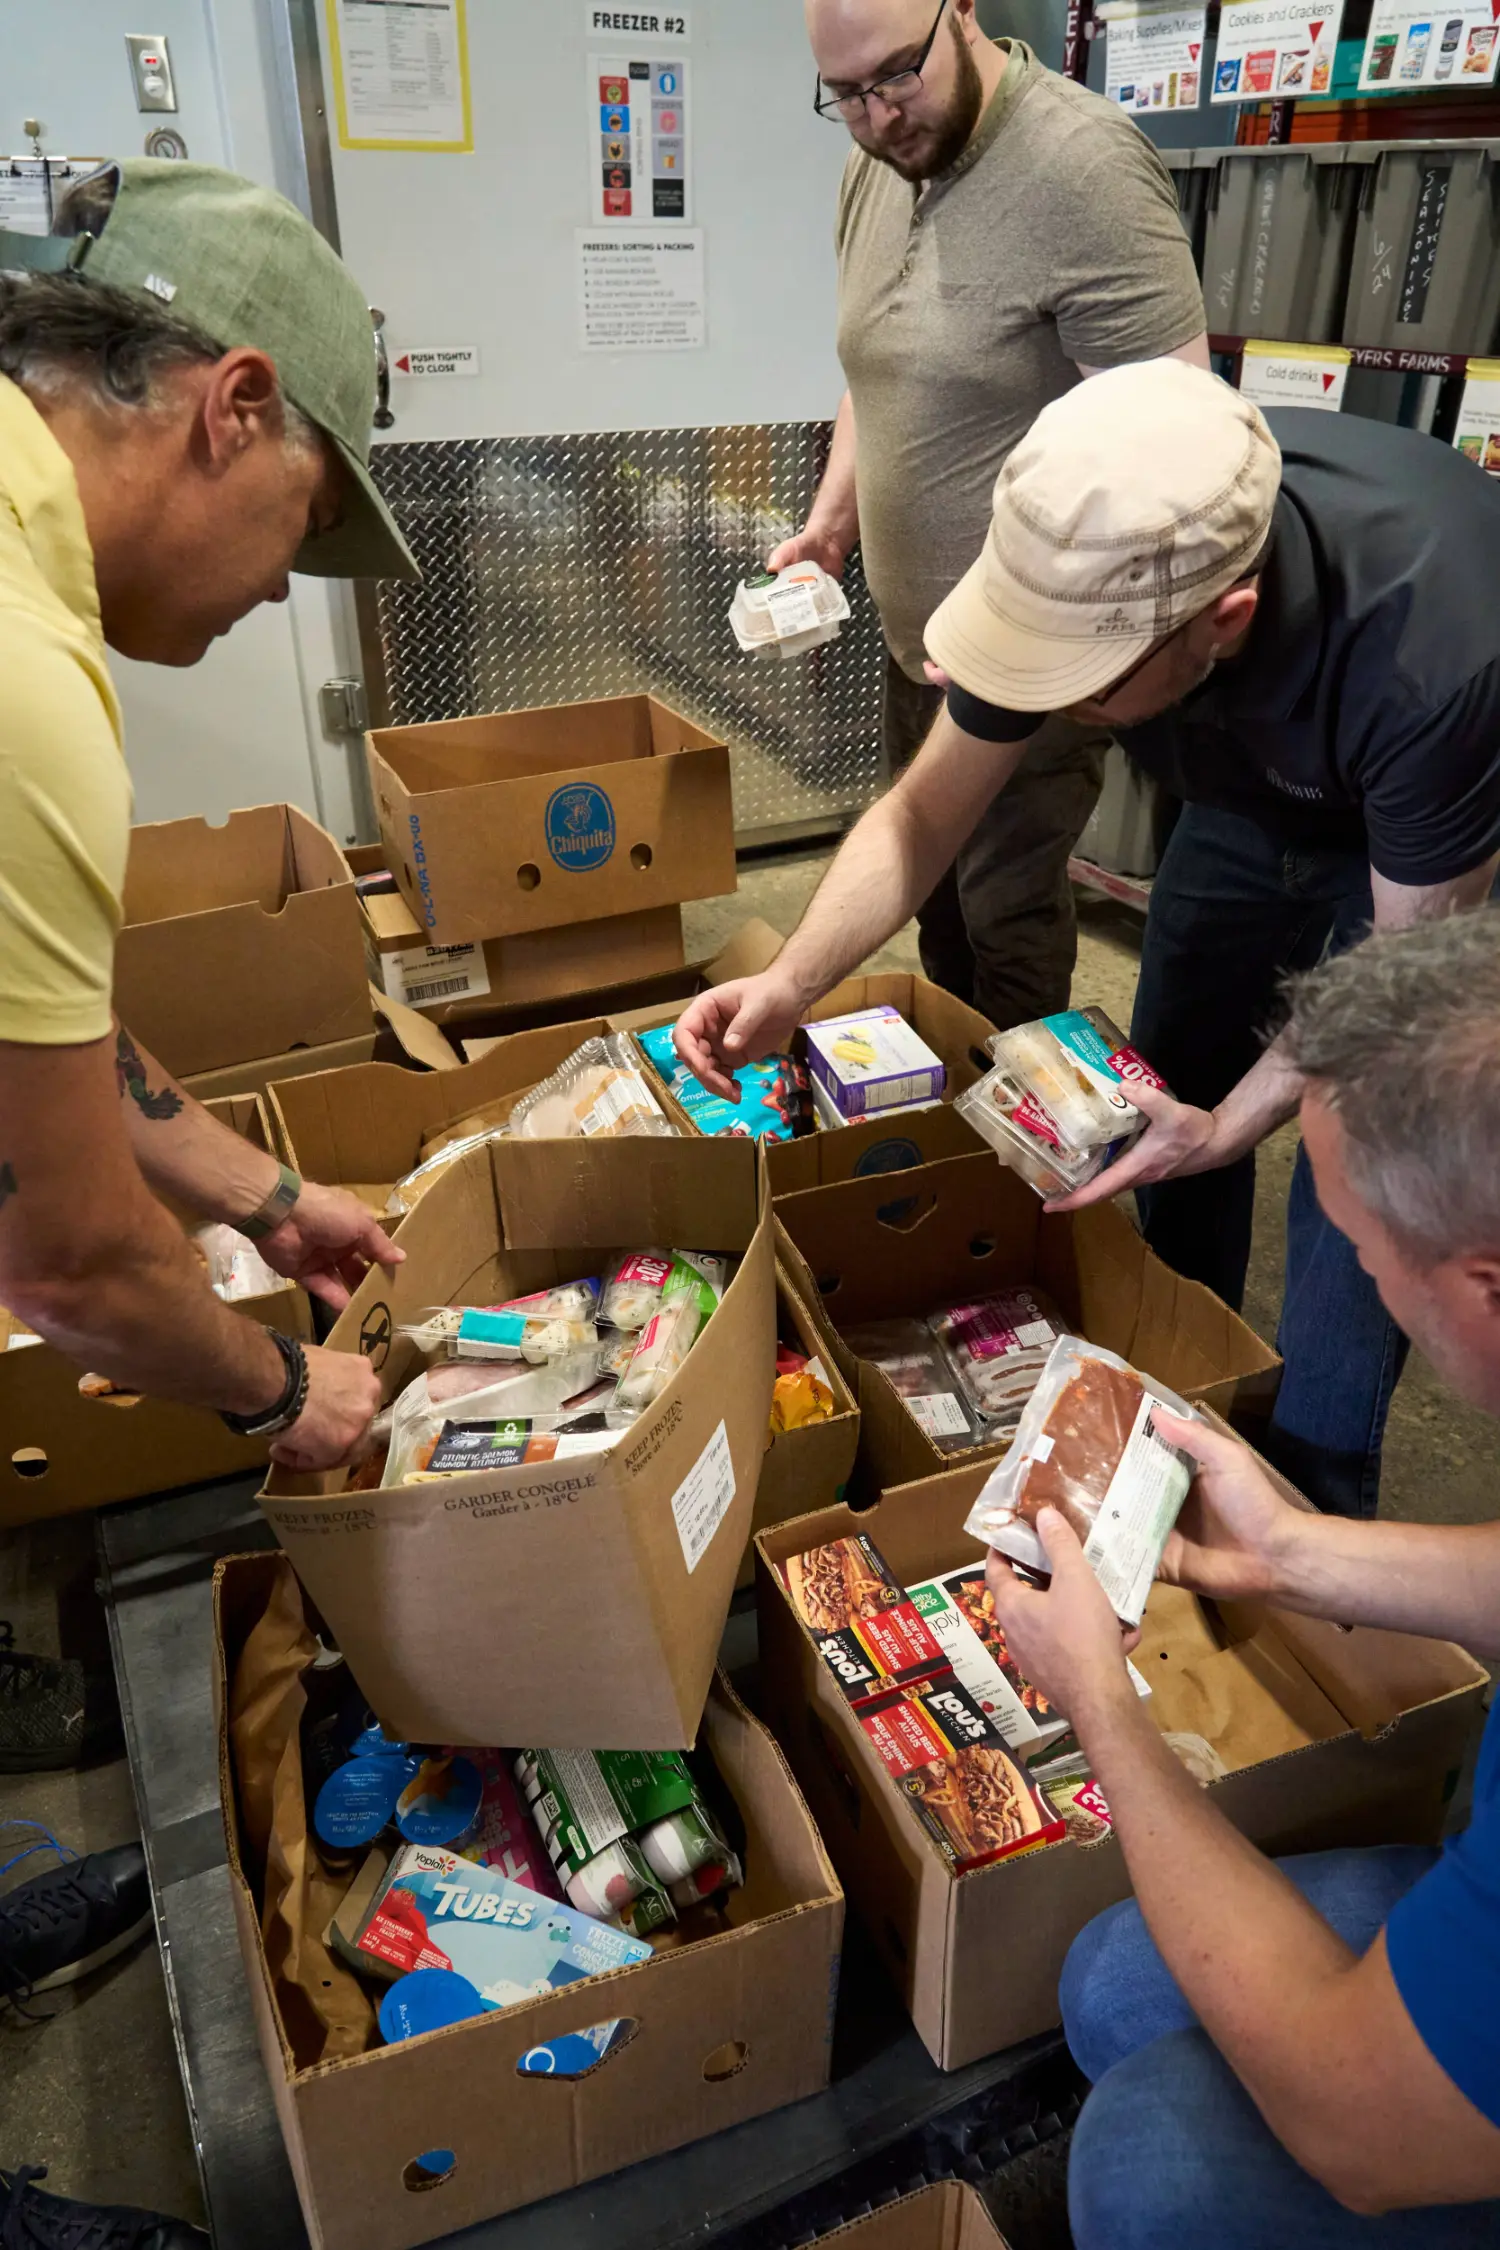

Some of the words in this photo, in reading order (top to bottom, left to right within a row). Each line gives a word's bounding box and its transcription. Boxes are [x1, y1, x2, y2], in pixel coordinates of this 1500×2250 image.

[592, 12, 660, 32] FREEZER
[664, 17, 685, 34] #2
[1228, 11, 1265, 27] Cookies
[1267, 8, 1287, 23] and
[1288, 4, 1335, 20] Crackers
[1108, 29, 1135, 43] Baking
[411, 353, 435, 362] PUSH
[437, 352, 472, 361] TIGHTLY
[1399, 352, 1451, 372] FARMS
[412, 365, 425, 374] TO
[427, 364, 455, 373] CLOSE
[1266, 365, 1286, 381] Cold
[1287, 367, 1319, 384] drinks
[551, 829, 613, 856] Chiquita
[636, 1258, 669, 1284] 30%
[624, 1436, 649, 1471] KEEP
[648, 1398, 683, 1442] FROZEN
[432, 1460, 468, 1468] SAUMON
[470, 1456, 520, 1468] ATLANTIQUE
[441, 1452, 480, 1461] ATLANTIC
[482, 1449, 516, 1459] SALMON
[631, 1452, 653, 1477] Store
[653, 1440, 662, 1454] at
[444, 1490, 516, 1512] GARDER
[517, 1473, 598, 1500] CONGELÉ
[274, 1511, 309, 1524] KEEP
[313, 1507, 376, 1524] FROZEN
[472, 1502, 520, 1519] Garder
[523, 1500, 531, 1511] à
[860, 1540, 871, 1552] 400
[885, 1590, 895, 1599] 5
[912, 1592, 934, 1605] althy
[915, 1599, 940, 1612] oice
[866, 1620, 881, 1640] BEEF
[890, 1608, 914, 1638] ÉMINCÉ
[907, 1618, 920, 1633] JUS
[881, 1629, 895, 1644] JUS
[915, 1632, 928, 1644] AU
[835, 1635, 861, 1665] KITCHEN
[879, 1640, 902, 1671] SHAVED
[890, 1644, 902, 1655] AU
[897, 1705, 922, 1737] SHAVED
[920, 1735, 939, 1758] BEEF
[898, 1721, 910, 1733] AU
[907, 1731, 921, 1749] JUS
[940, 1710, 971, 1742] KITCHEN
[872, 1733, 884, 1746] AU
[880, 1743, 894, 1761] JUS
[887, 1739, 913, 1771] ÉMINCÉ
[909, 1781, 918, 1791] 5
[941, 1841, 954, 1855] 400
[414, 1852, 446, 1871] Yoplait
[433, 1882, 538, 1927] TUBES
[379, 1928, 396, 1939] FRAISE
[384, 1919, 415, 1937] STRAWBERRY
